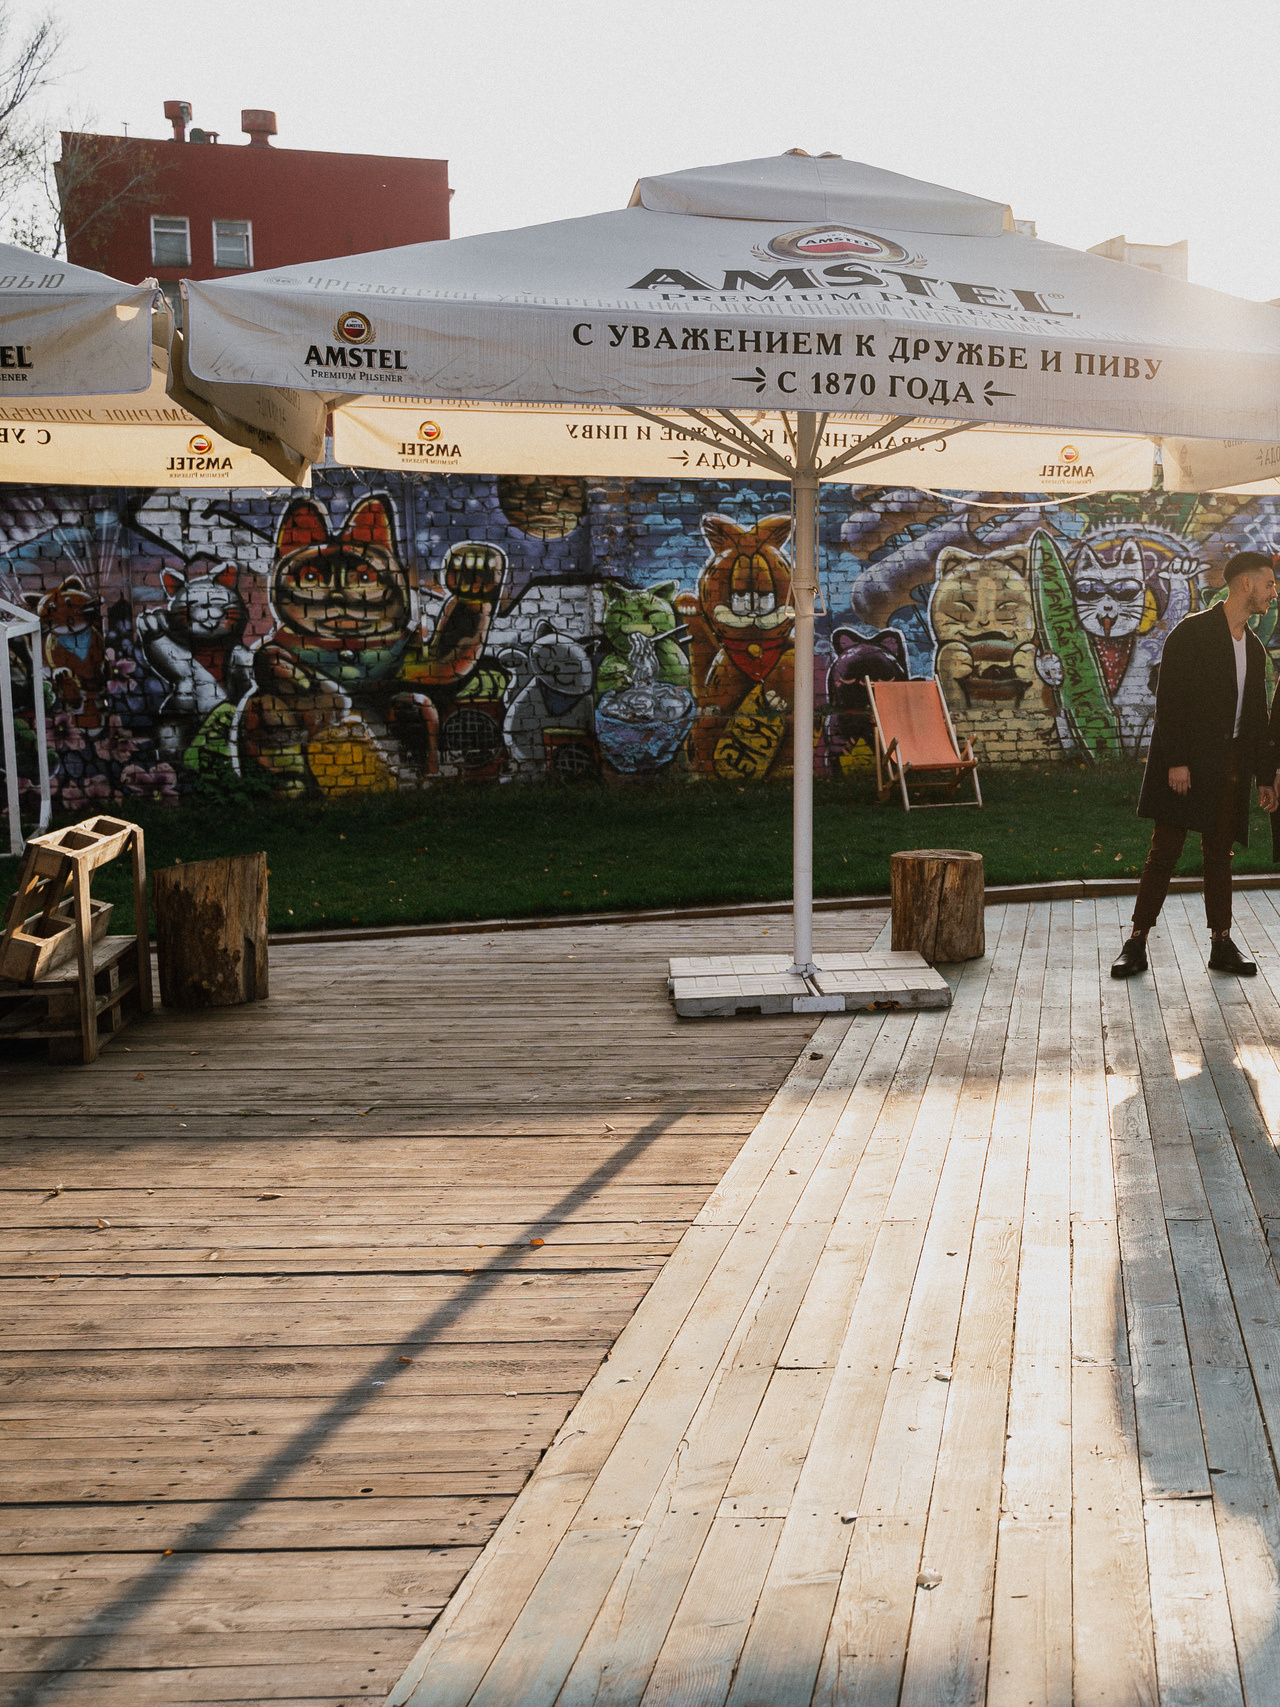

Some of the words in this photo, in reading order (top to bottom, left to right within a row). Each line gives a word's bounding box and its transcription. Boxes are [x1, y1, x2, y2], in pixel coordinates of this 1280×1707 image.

[805, 236, 876, 247] AMSTEL
[626, 262, 1081, 318] AMSTEL
[661, 291, 862, 302] PREMIUM
[881, 292, 1065, 326] PILSENER
[304, 346, 407, 370] AMSTEL
[573, 323, 592, 345] С
[608, 325, 842, 358] УВАЖЕНИЕМ
[856, 335, 876, 358] К
[889, 336, 1027, 372] ДРУЖБЕ
[1040, 351, 1062, 374] И
[1074, 353, 1163, 381] ПИВУ
[310, 369, 356, 380] PREMIUM
[359, 371, 403, 383] PILSENER
[778, 371, 797, 394] С
[810, 372, 876, 398] 1870
[889, 376, 975, 404] ГОДА
